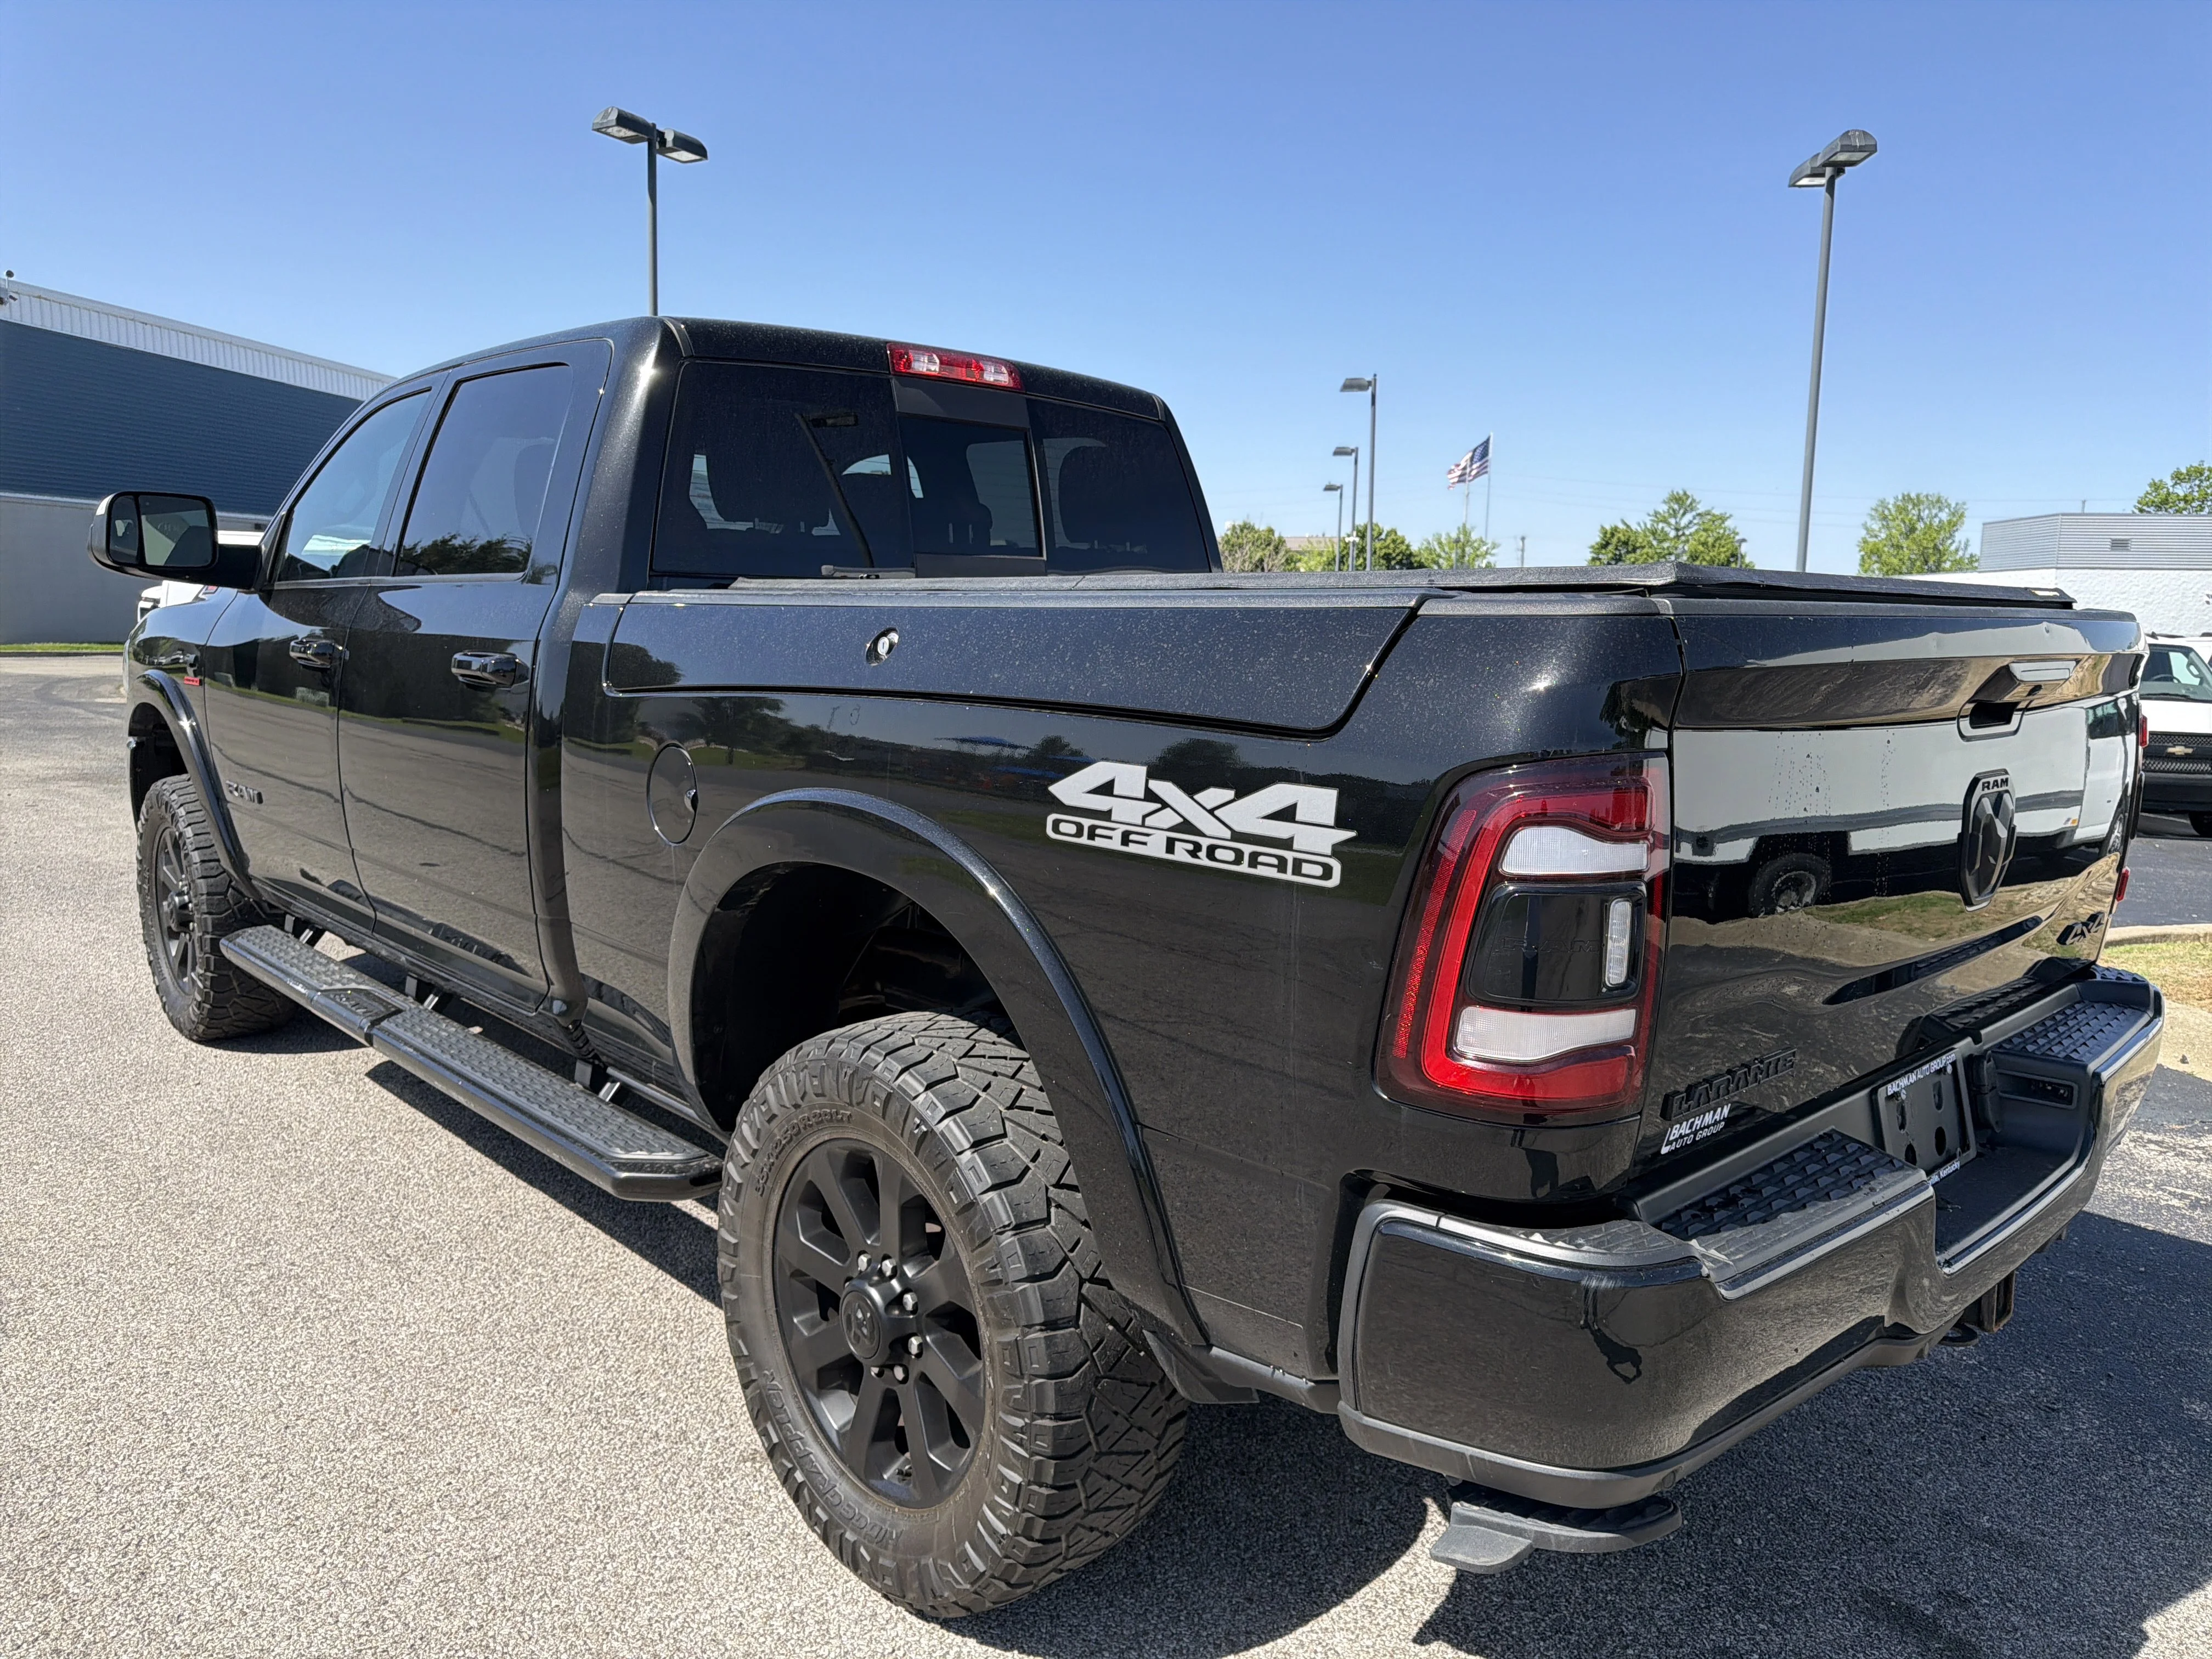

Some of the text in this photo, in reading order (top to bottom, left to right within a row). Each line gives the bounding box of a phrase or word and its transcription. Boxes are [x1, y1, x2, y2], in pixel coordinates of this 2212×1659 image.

[1981, 777, 2009, 792] RAM
[1051, 818, 1334, 881] OFF ROAD
[1887, 1070, 1917, 1096] BACHMAN
[1917, 1064, 1930, 1080] AUTO
[1669, 1103, 1731, 1141] BACHMAN
[1670, 1122, 1725, 1152] AUTO GROUP
[1939, 1160, 1960, 1179] Kentucky
